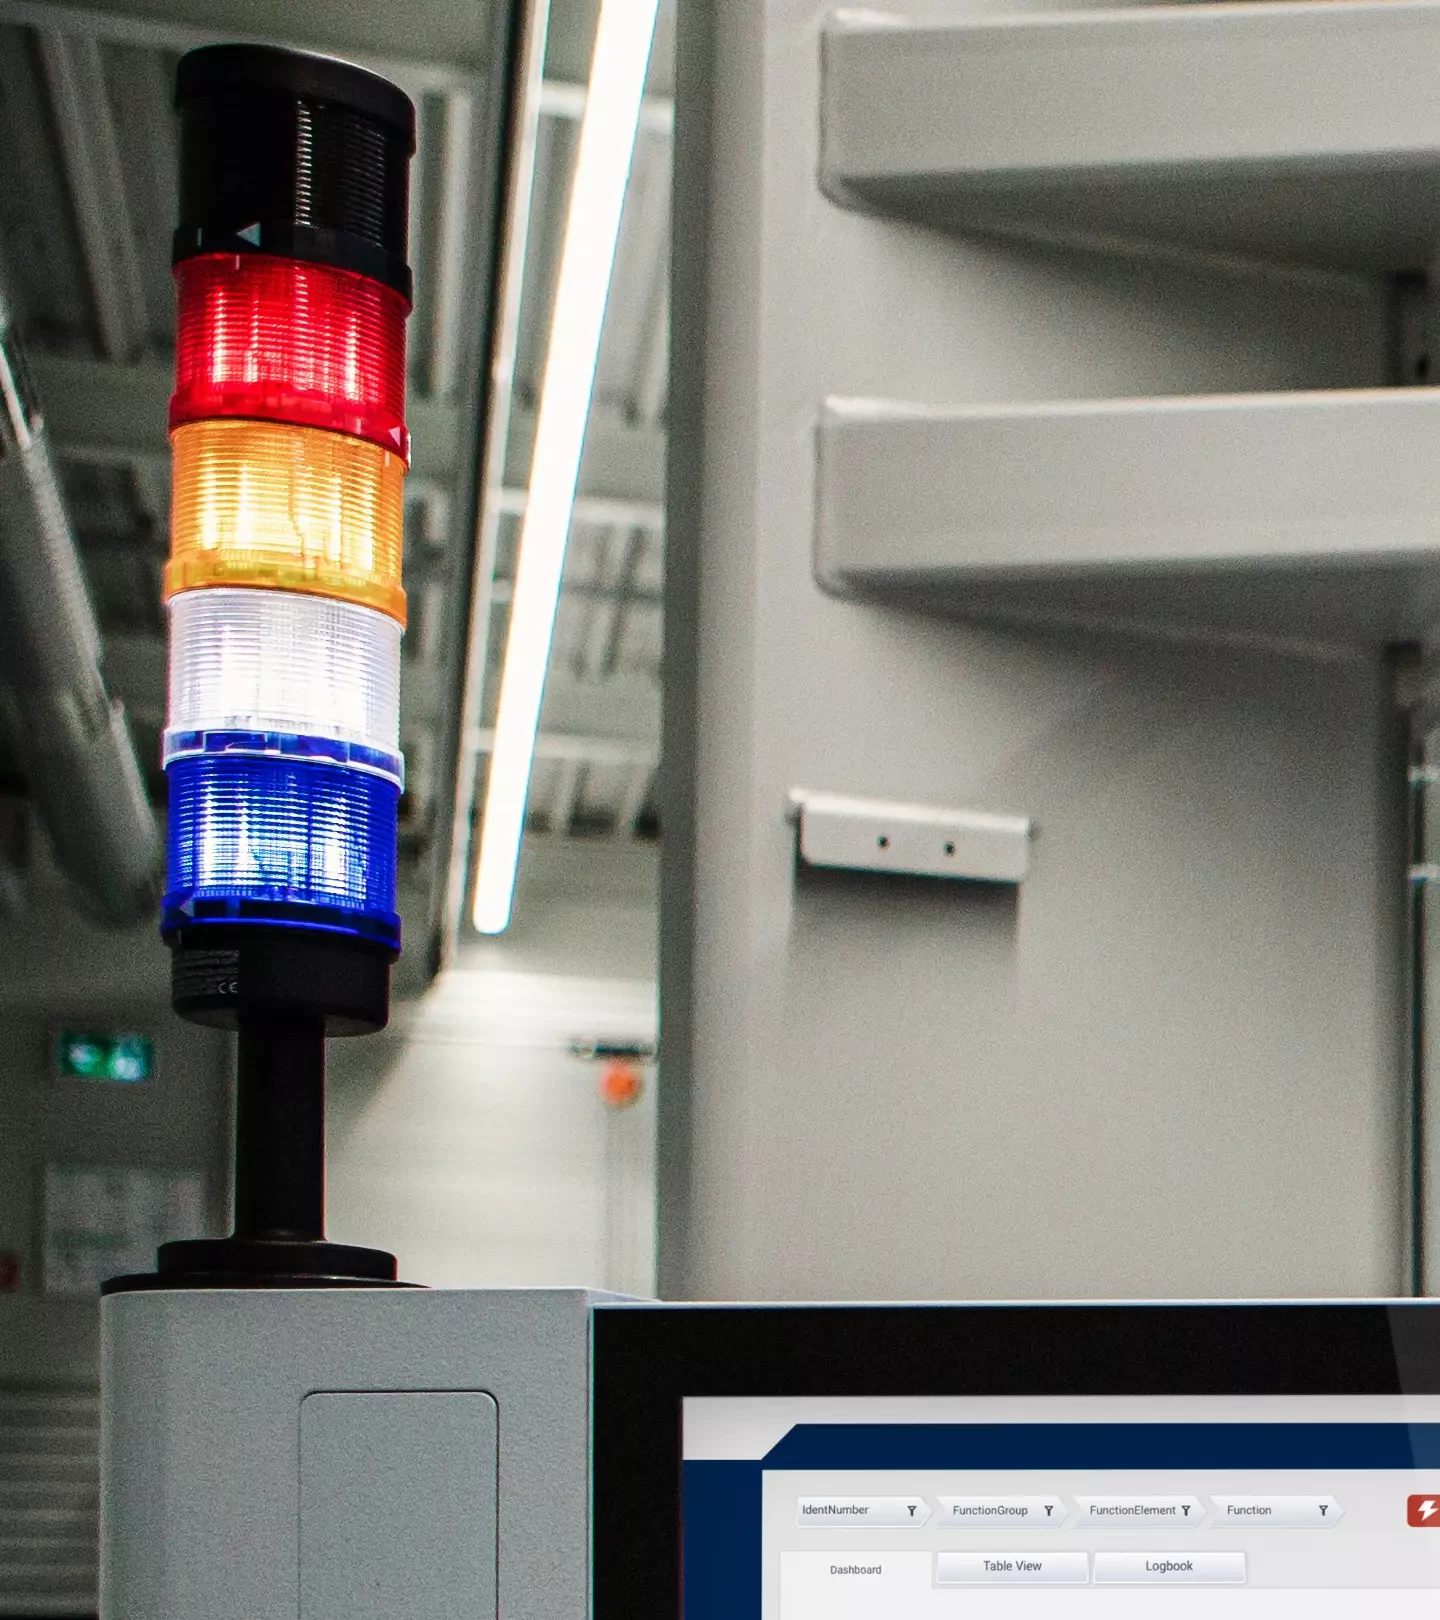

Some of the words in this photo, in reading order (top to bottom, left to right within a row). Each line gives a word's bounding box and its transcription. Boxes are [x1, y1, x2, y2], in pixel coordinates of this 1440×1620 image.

[802, 1504, 869, 1515] IdentNumber
[953, 1505, 1029, 1517] FunctionGroup
[1089, 1505, 1176, 1516] FunctionElement
[1227, 1504, 1272, 1516] Function
[830, 1564, 882, 1575] Dashboard
[983, 1560, 1013, 1572] Table
[1015, 1560, 1043, 1572] View
[1145, 1560, 1194, 1574] Logbook
